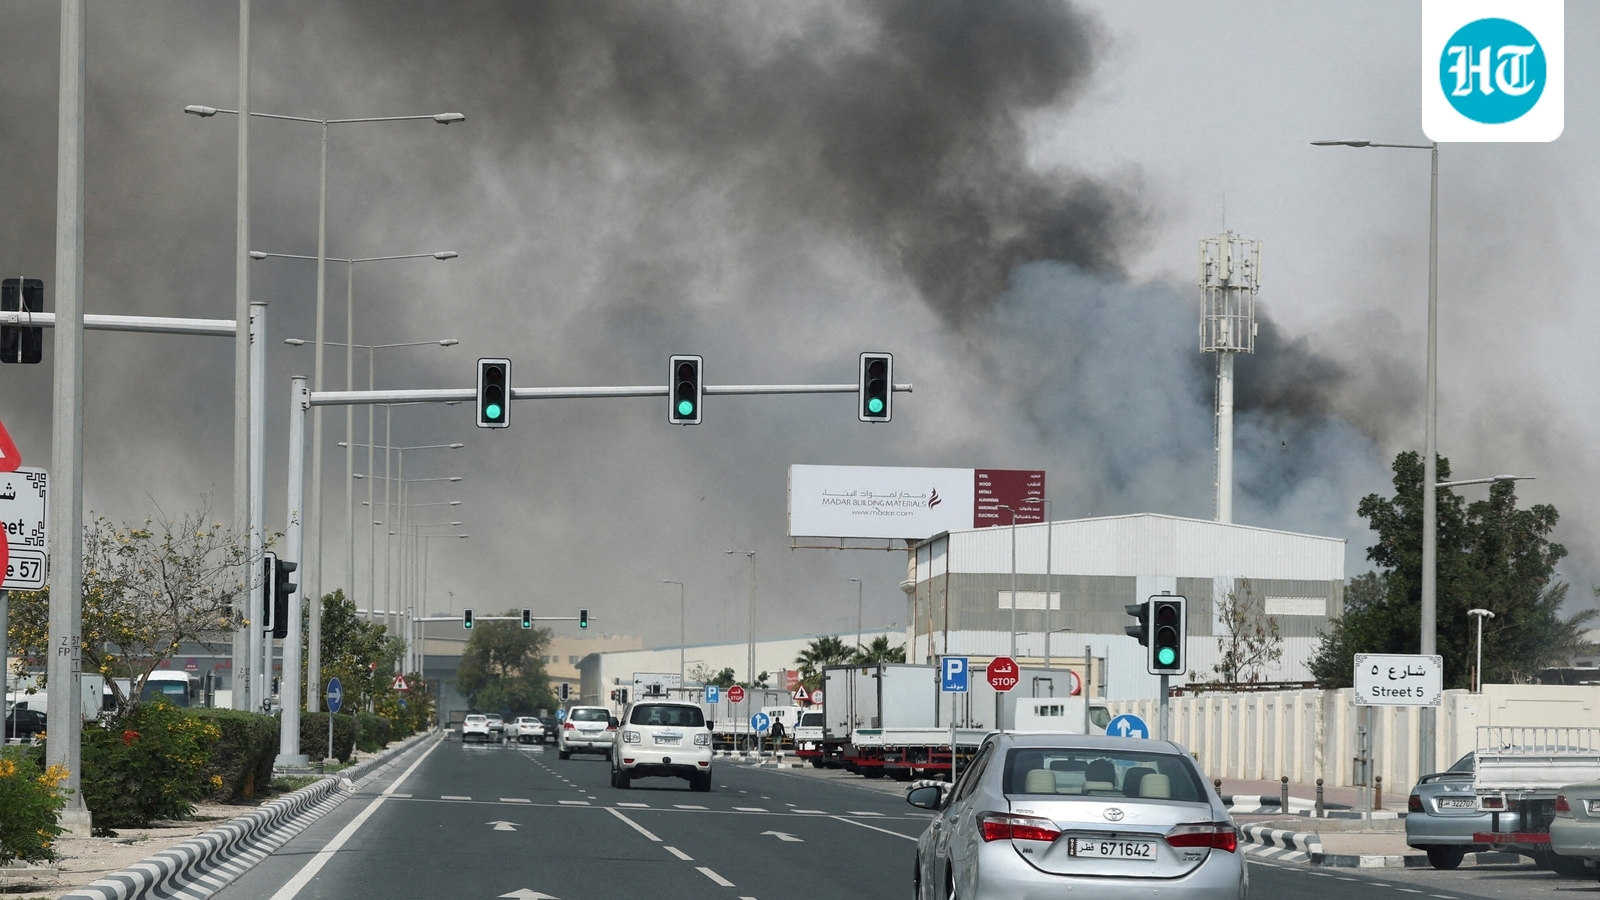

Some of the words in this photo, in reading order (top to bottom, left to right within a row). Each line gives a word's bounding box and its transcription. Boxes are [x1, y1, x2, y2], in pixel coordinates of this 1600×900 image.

[821, 498, 852, 506] MADAR
[852, 499, 885, 507] BUILDING
[885, 500, 927, 508] MATERIALS
[20, 561, 40, 579] 57
[61, 636, 68, 646] Z
[947, 660, 963, 680] P
[994, 663, 1012, 673] قف
[1388, 665, 1426, 680] شارع
[992, 678, 1016, 686] STOP
[1372, 685, 1412, 698] Street
[1416, 686, 1424, 698] 5
[1078, 842, 1095, 853] قطر
[1100, 842, 1151, 858] 671642
